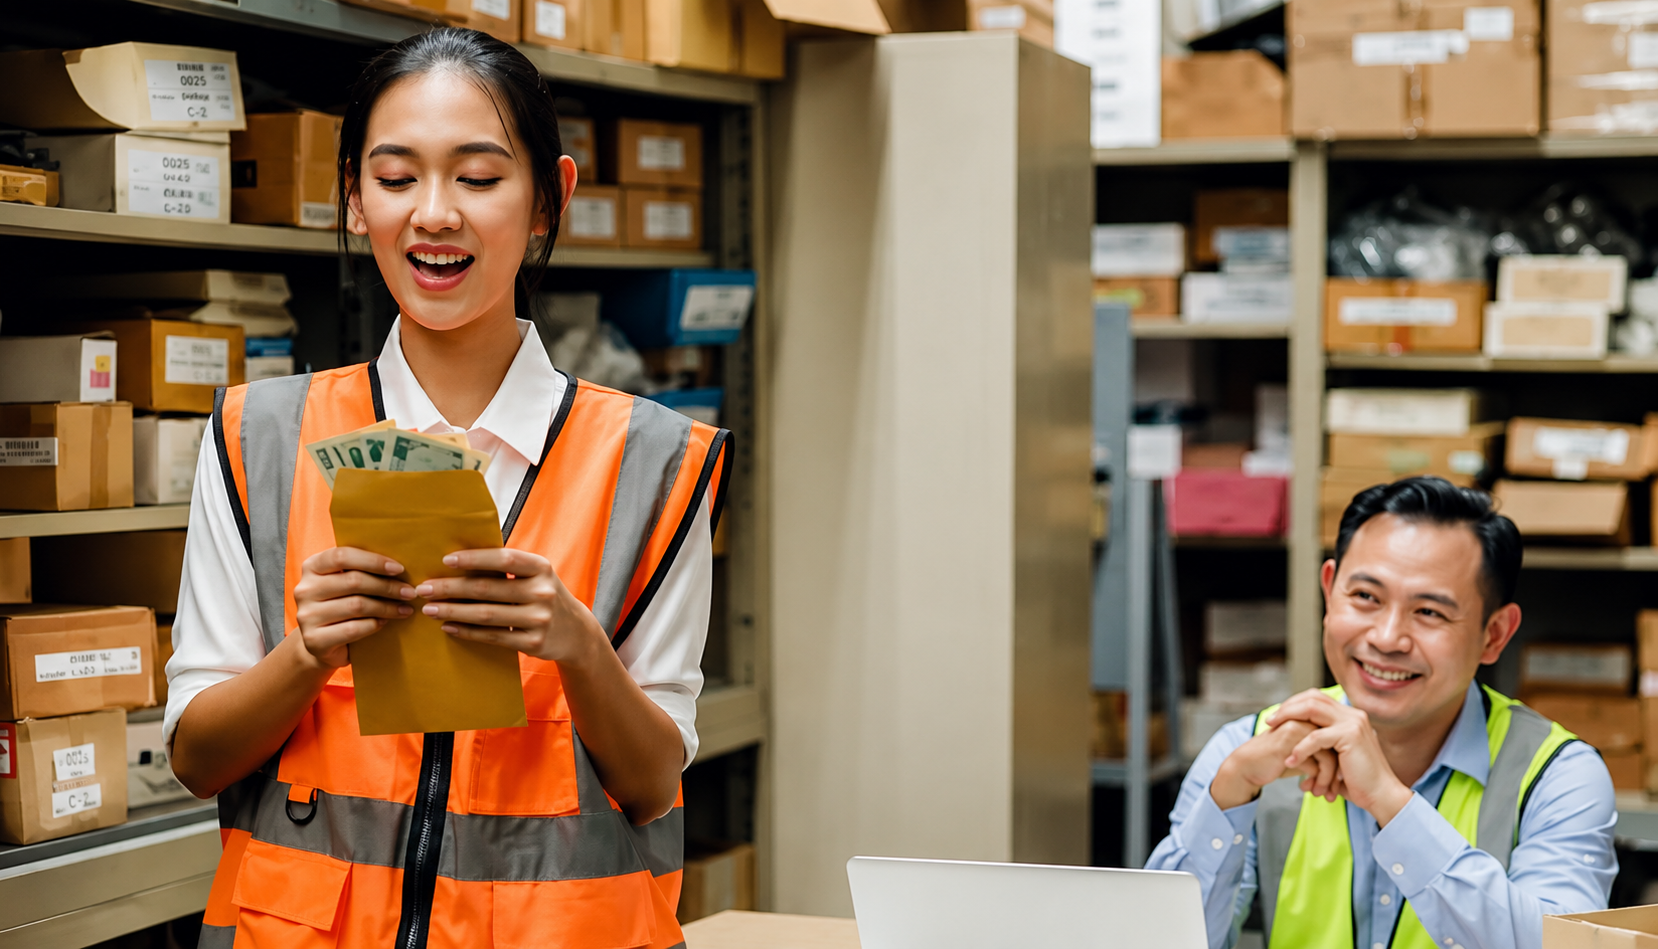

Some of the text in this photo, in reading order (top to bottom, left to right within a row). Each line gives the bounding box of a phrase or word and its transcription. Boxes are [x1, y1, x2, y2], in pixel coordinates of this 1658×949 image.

[180, 75, 207, 87] 0025
[187, 106, 208, 118] C-2
[162, 156, 190, 170] 0025
